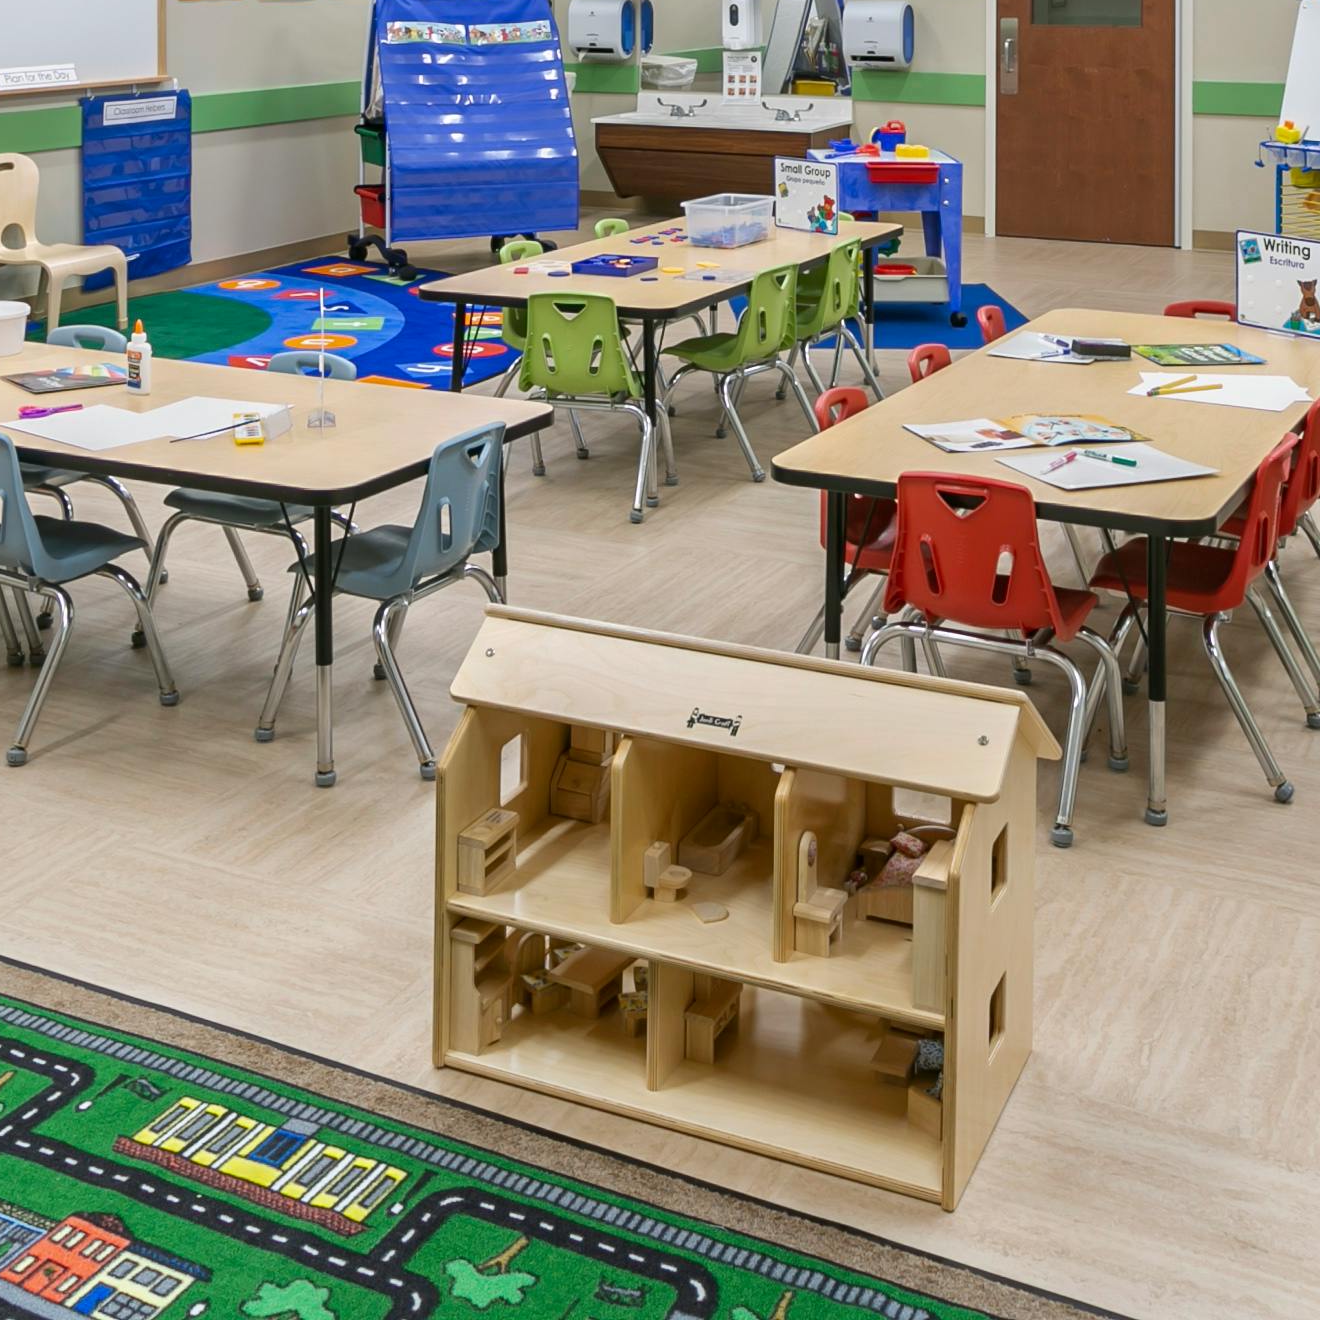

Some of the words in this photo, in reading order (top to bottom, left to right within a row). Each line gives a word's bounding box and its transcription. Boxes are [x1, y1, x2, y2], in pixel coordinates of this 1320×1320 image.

[4, 73, 23, 83] Plan
[38, 71, 52, 81] the
[54, 70, 70, 81] Day
[781, 163, 803, 174] Small
[804, 165, 831, 179] Group
[1263, 238, 1311, 260] Writing
[1270, 256, 1305, 269] Escritura
